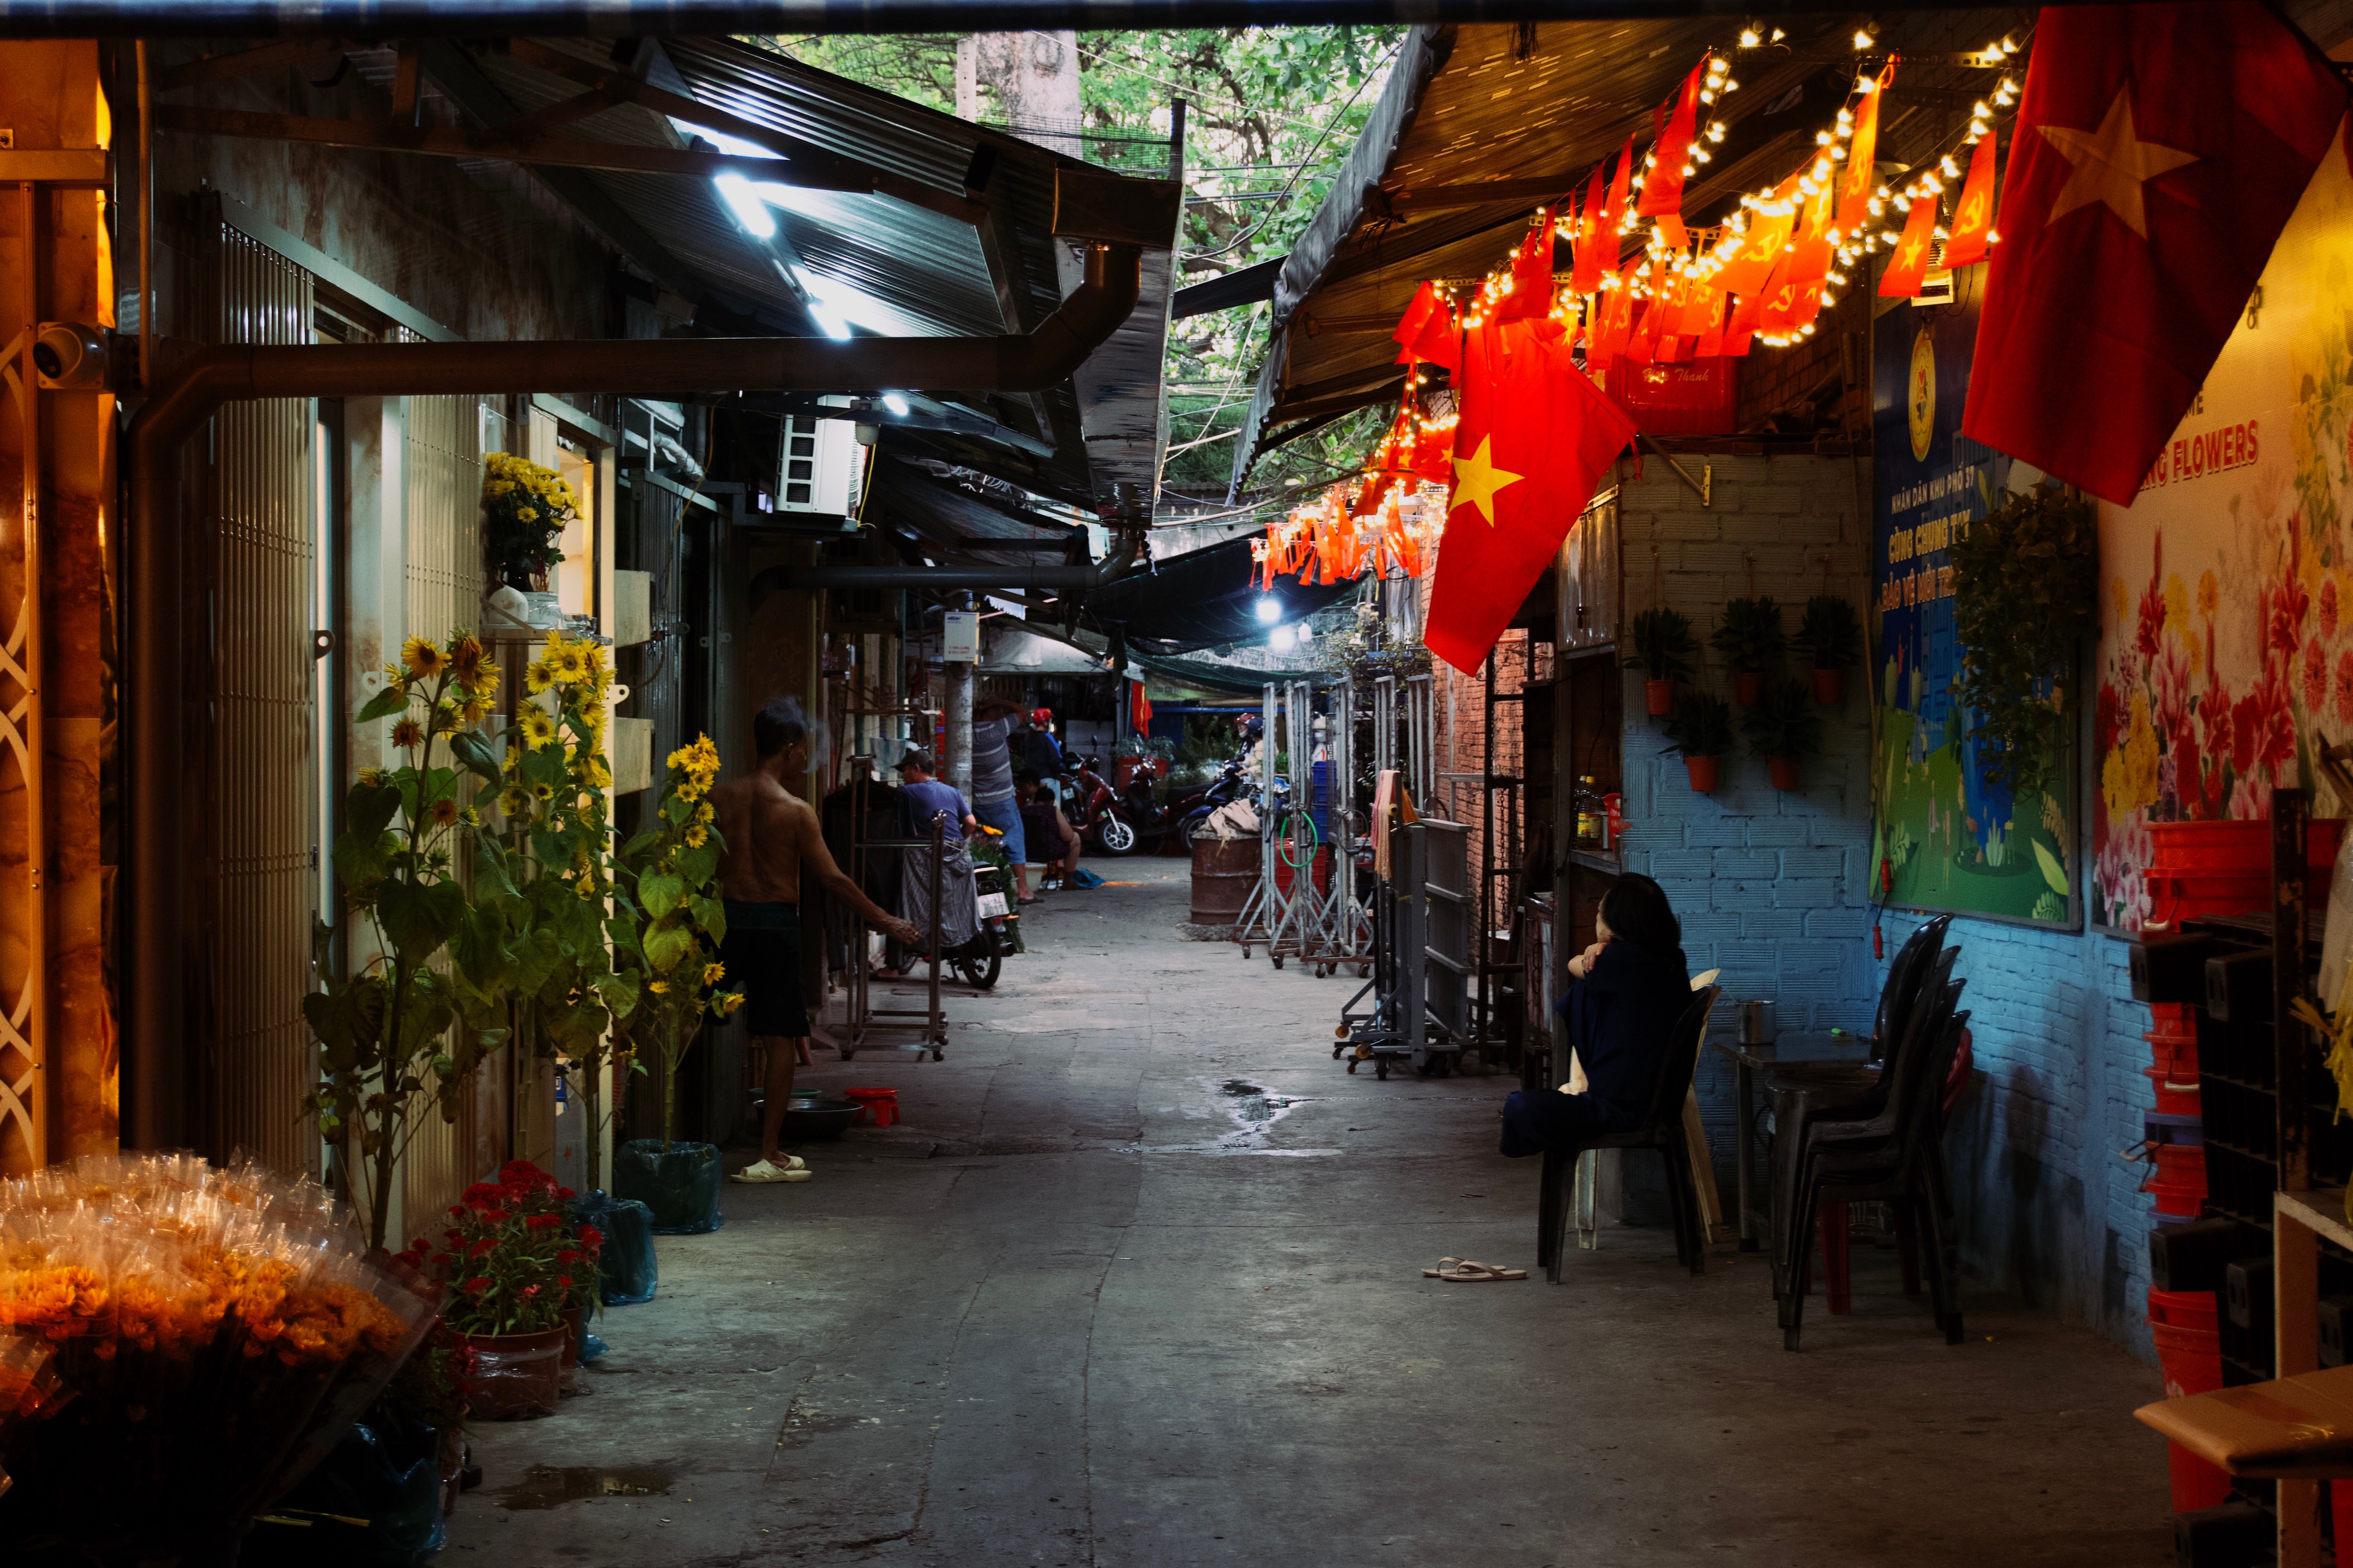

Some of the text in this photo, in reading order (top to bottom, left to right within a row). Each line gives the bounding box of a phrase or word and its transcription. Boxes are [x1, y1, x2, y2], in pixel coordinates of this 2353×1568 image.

[2173, 420, 2258, 483] FLOWERS
[1891, 461, 1975, 514] NHÂN DÂN KHU PHỐ 37
[1888, 526, 1913, 564] CÙNG
[1915, 517, 1948, 556] CHUNG
[1903, 568, 1915, 613] VỆ
[1917, 563, 1936, 603] MÔI
